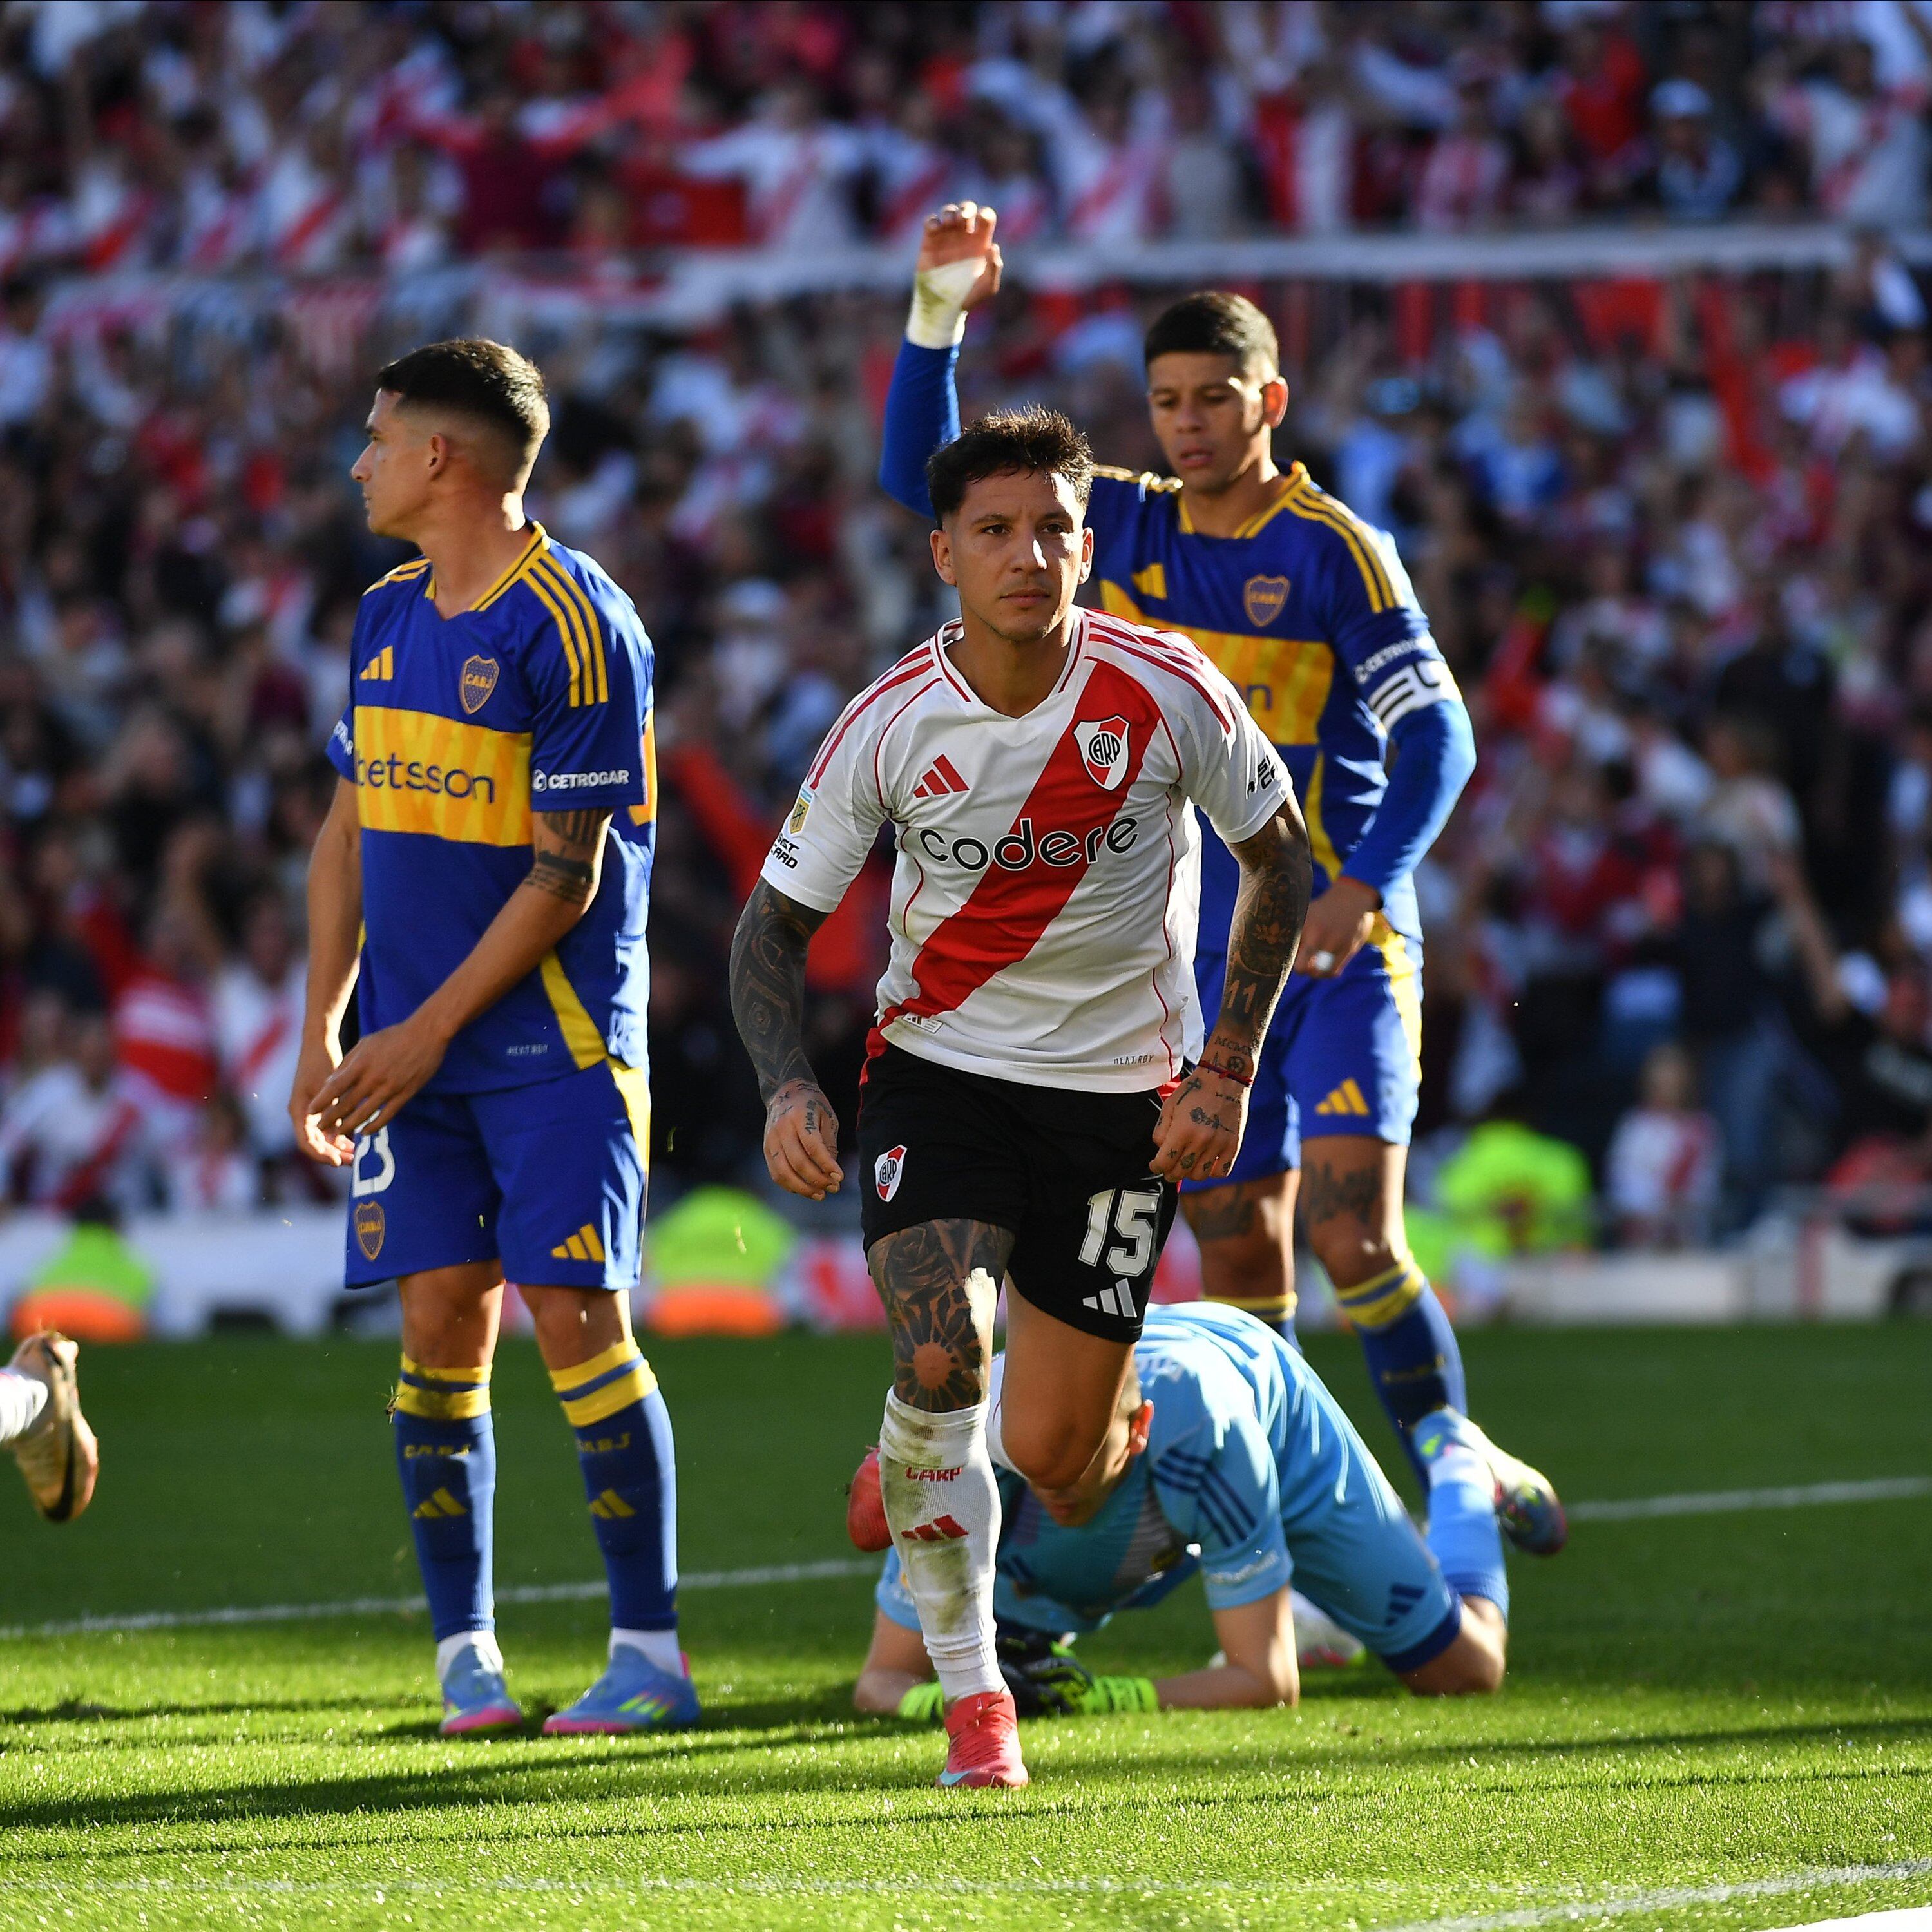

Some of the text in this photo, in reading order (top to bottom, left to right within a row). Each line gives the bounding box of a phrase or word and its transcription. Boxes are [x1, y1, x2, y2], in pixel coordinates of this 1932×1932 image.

[1088, 732, 1121, 766] CARP
[548, 769, 629, 790] CETROGAR
[771, 845, 798, 869] ARD
[919, 816, 1139, 871] codere
[1078, 1188, 1160, 1277] 15
[905, 1466, 962, 1482] CARP
